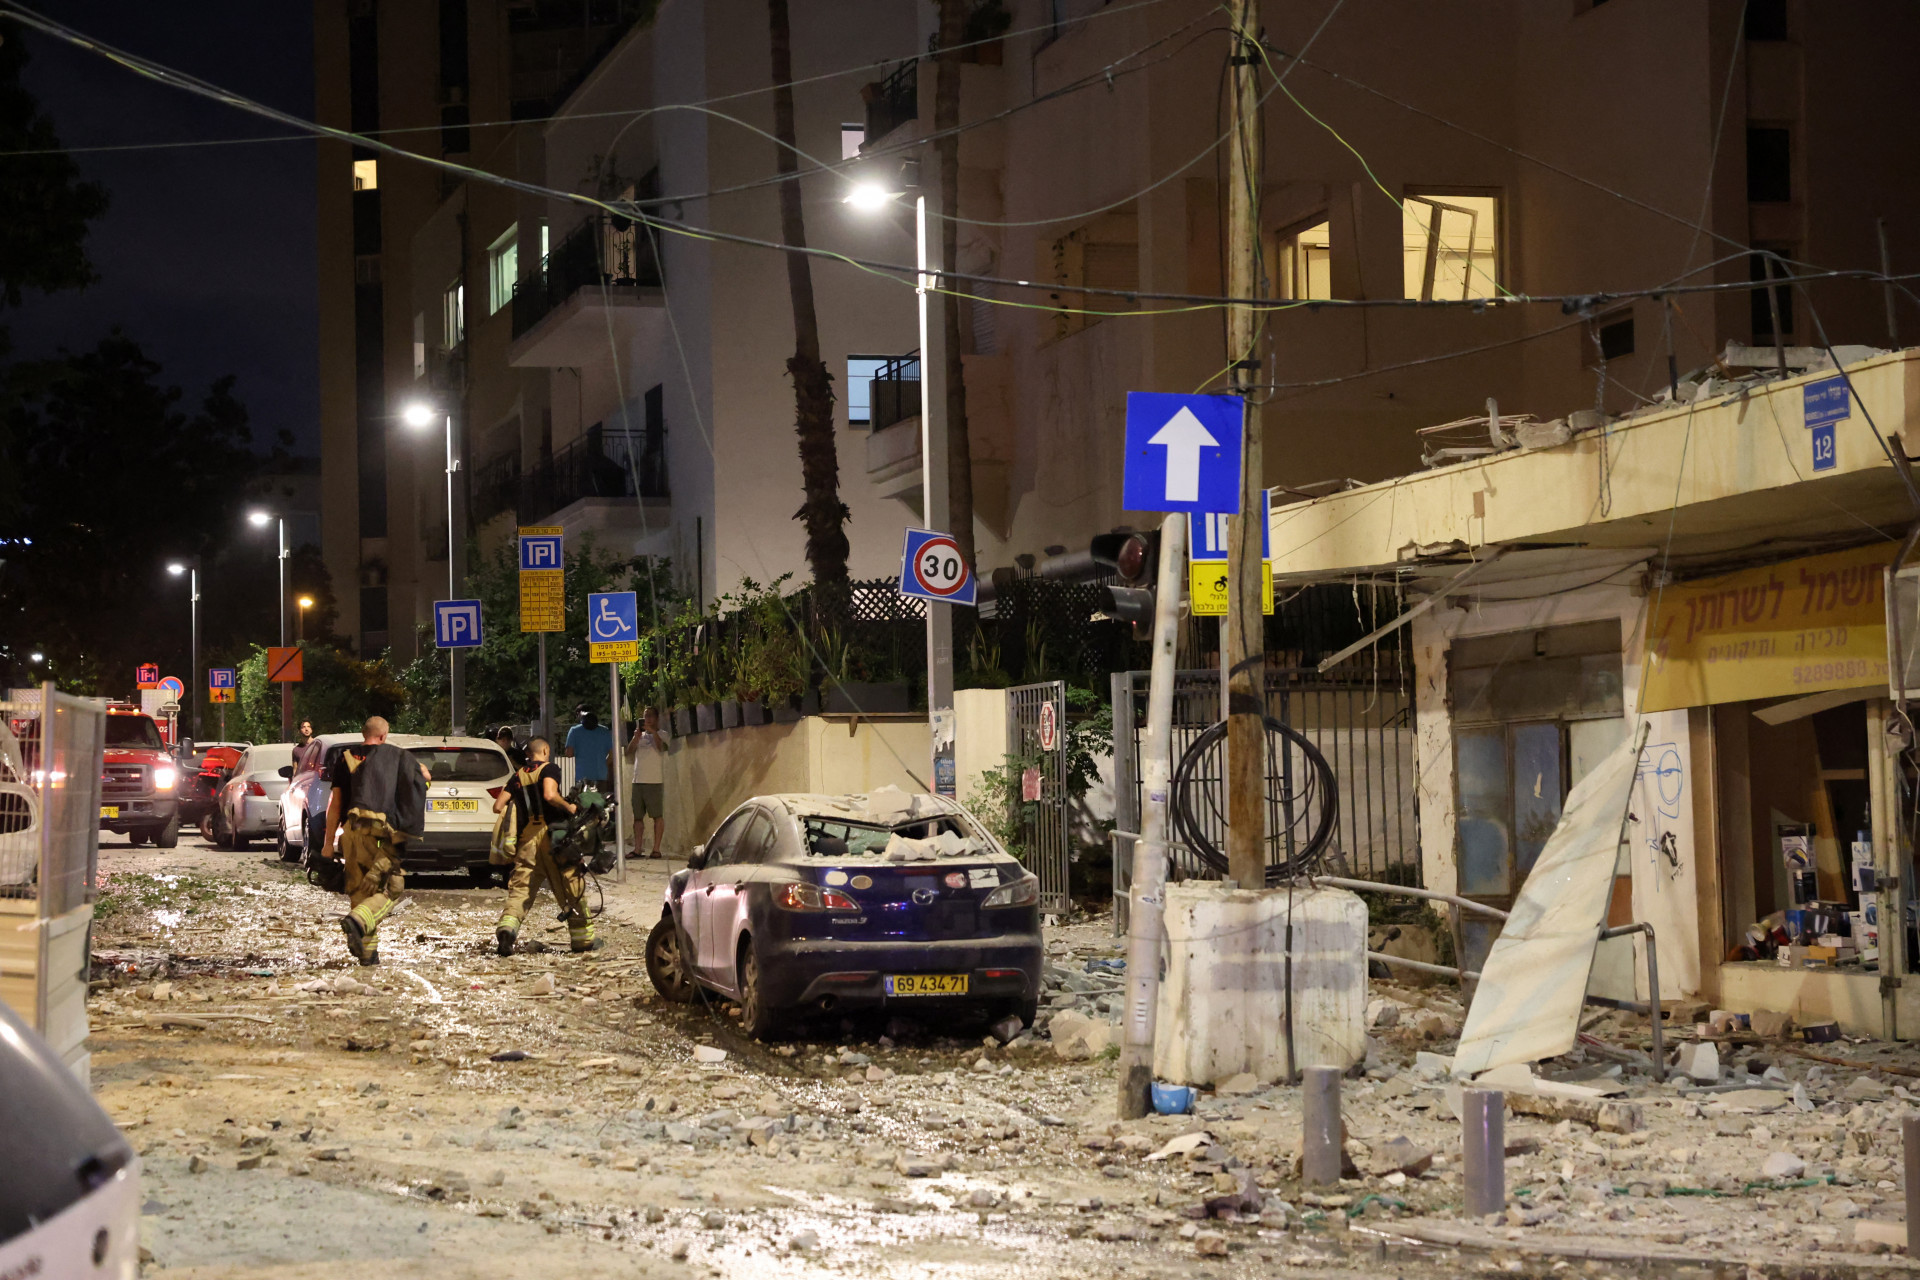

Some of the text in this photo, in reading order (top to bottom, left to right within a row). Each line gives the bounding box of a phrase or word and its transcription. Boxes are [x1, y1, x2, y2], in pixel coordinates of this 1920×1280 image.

[1815, 435, 1832, 461] 12
[924, 554, 959, 581] 30
[1794, 626, 1848, 652] מכירה
